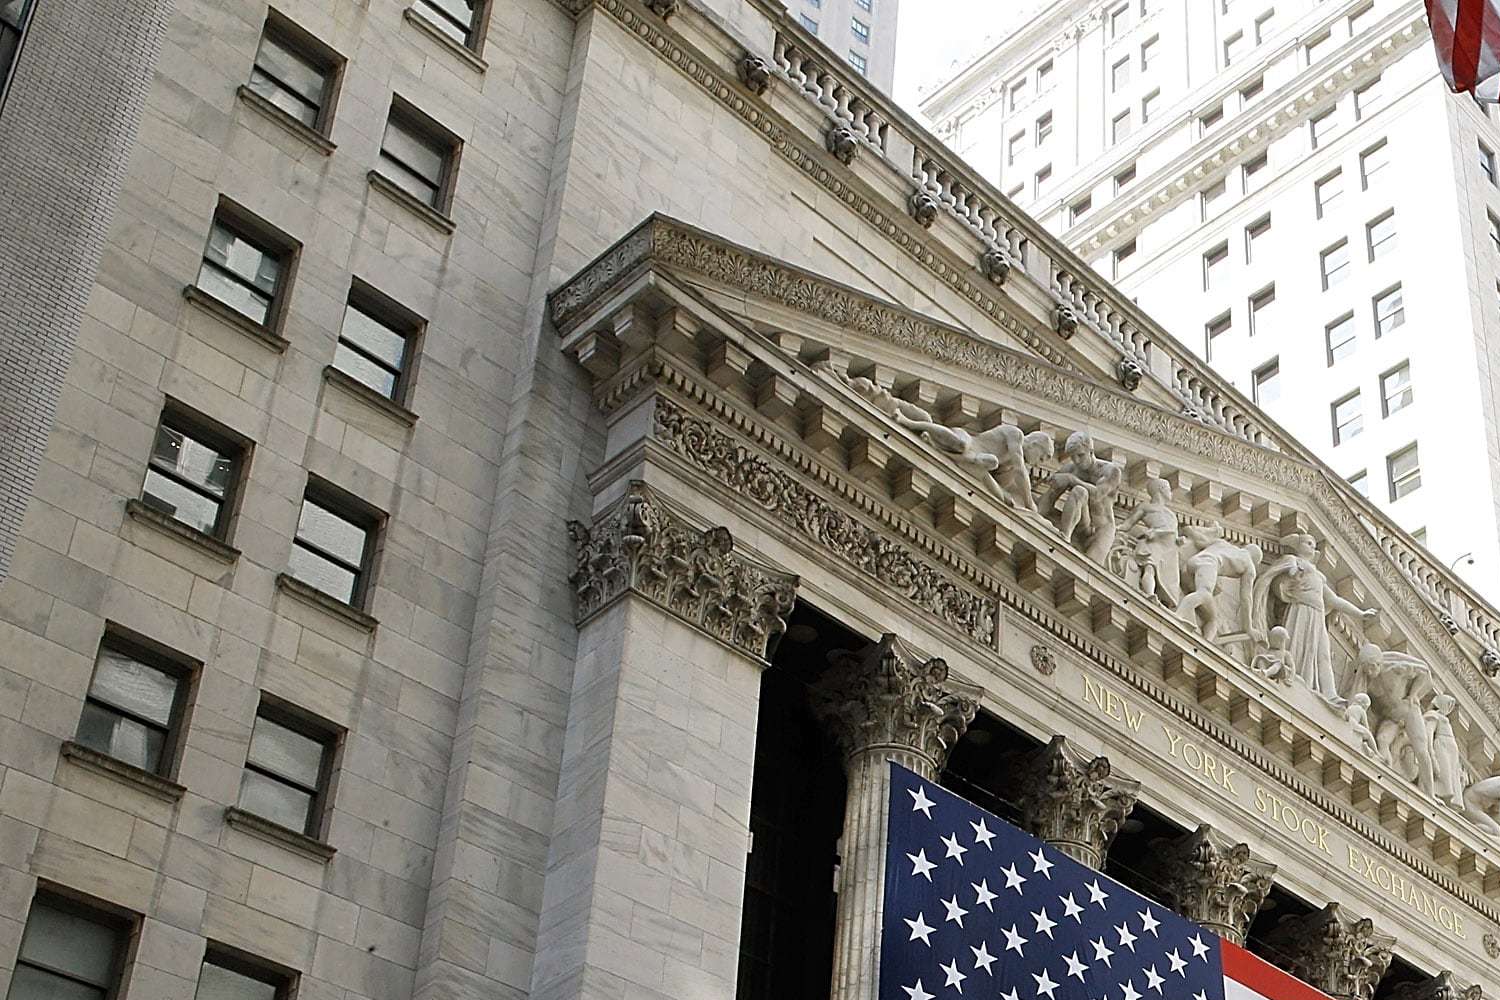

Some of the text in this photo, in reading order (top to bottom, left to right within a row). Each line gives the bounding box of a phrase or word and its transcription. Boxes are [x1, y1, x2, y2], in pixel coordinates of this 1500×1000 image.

[1083, 675, 1467, 941] NEW YORK STOCK EXCHANGE
